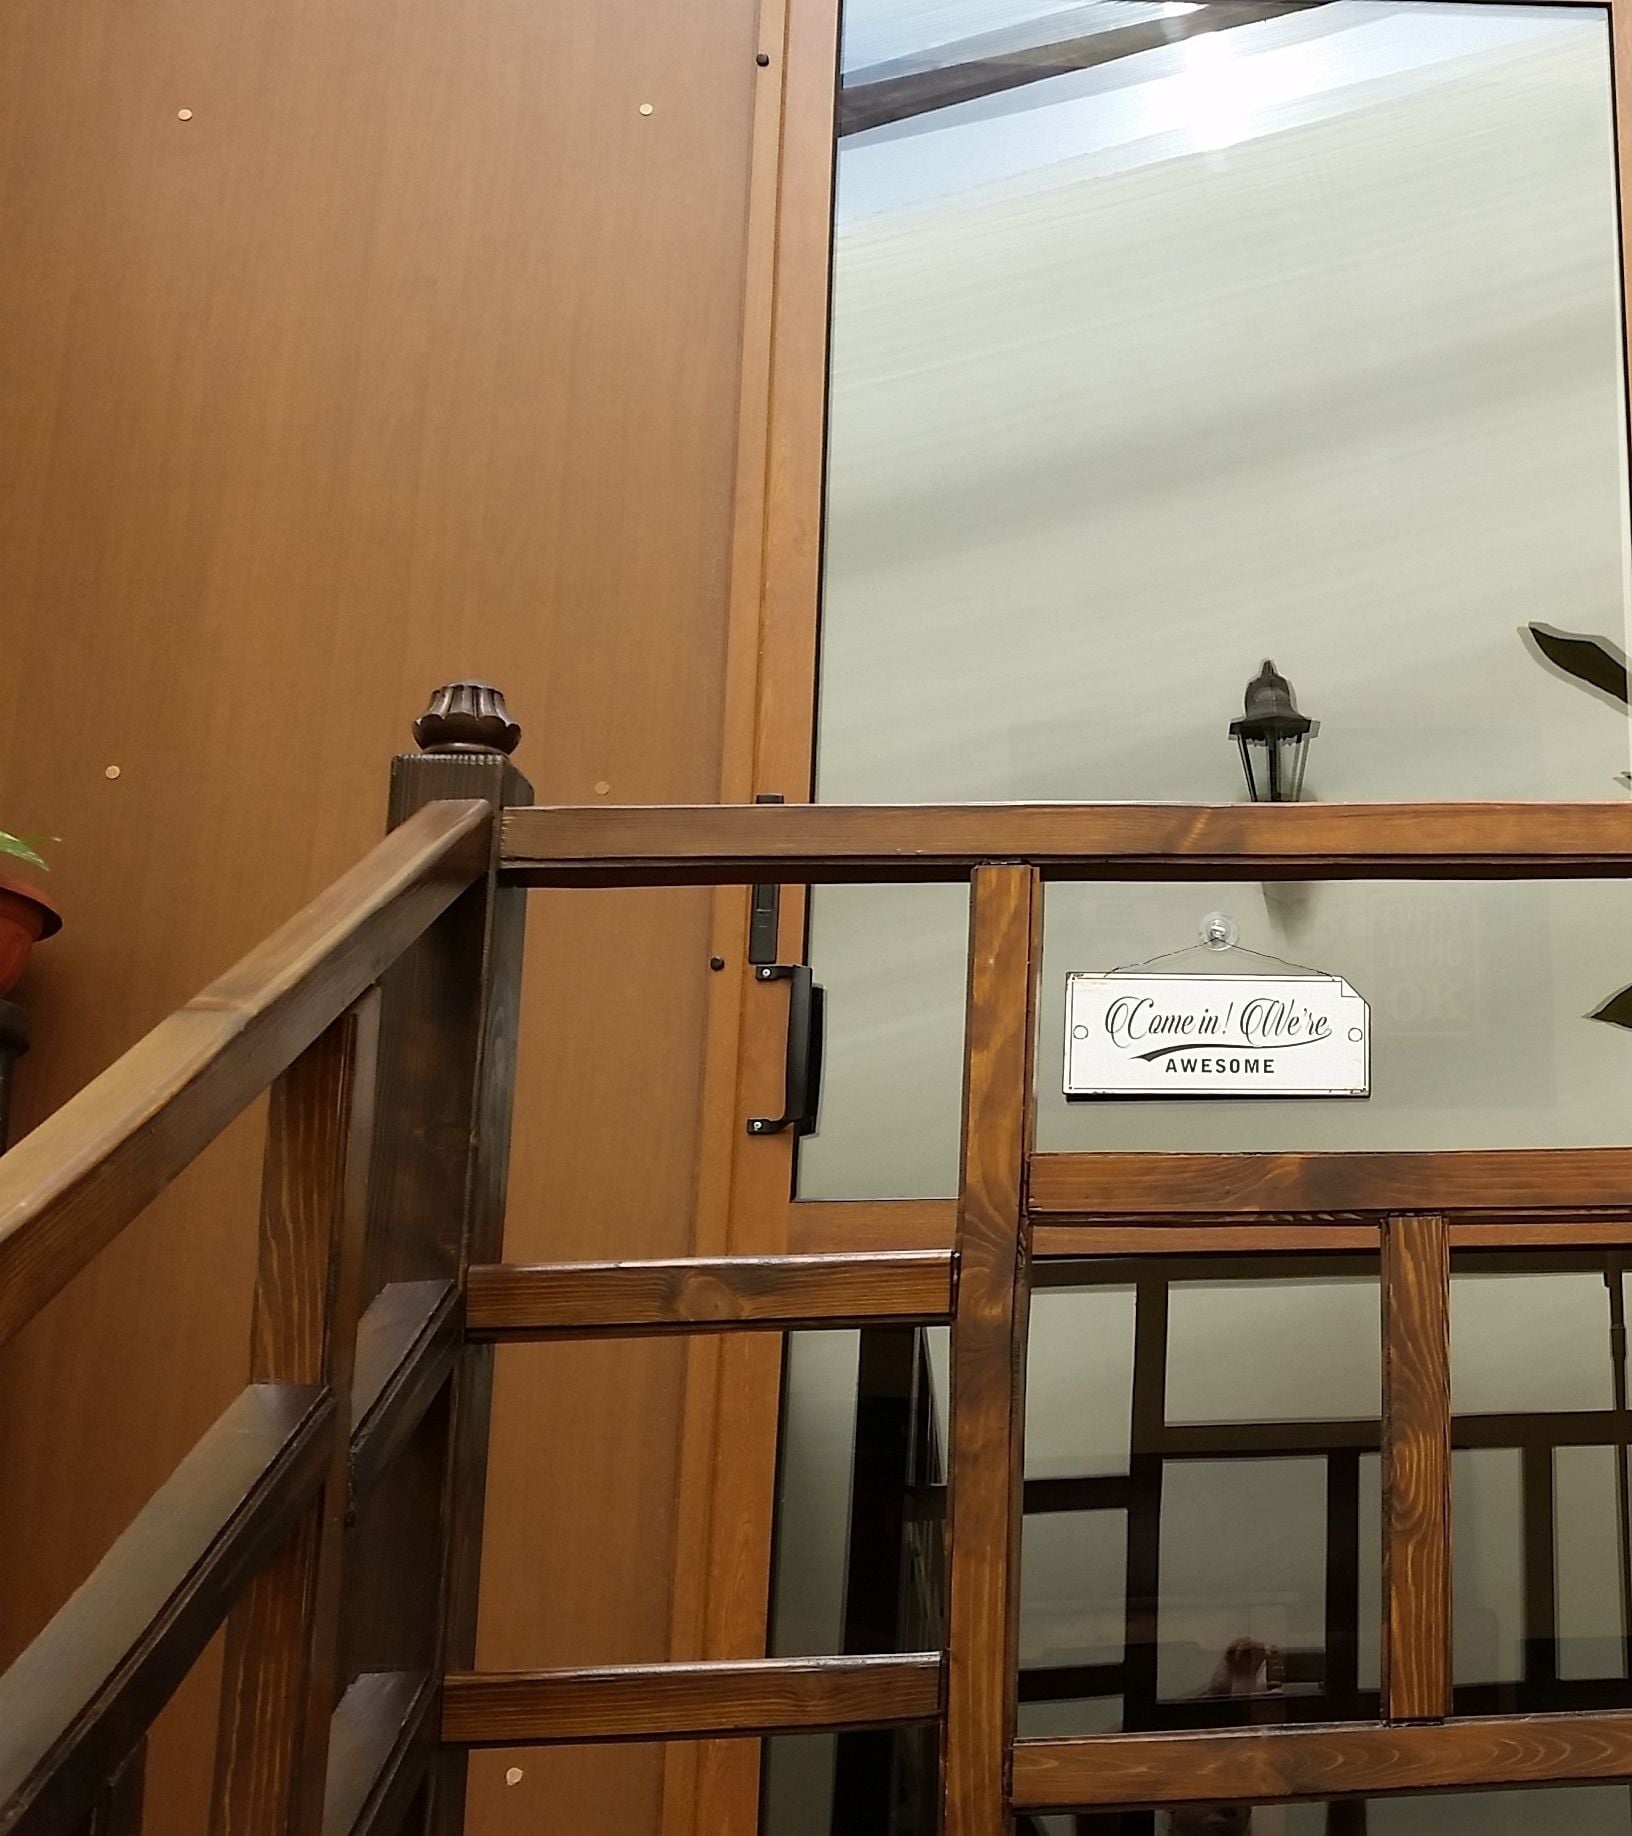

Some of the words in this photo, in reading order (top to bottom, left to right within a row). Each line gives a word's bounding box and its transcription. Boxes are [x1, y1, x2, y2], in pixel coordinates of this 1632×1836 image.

[1105, 996, 1195, 1048] Come
[1198, 1001, 1234, 1035] in!
[1240, 998, 1331, 1046] We're
[1165, 1058, 1275, 1074] AWESOME
